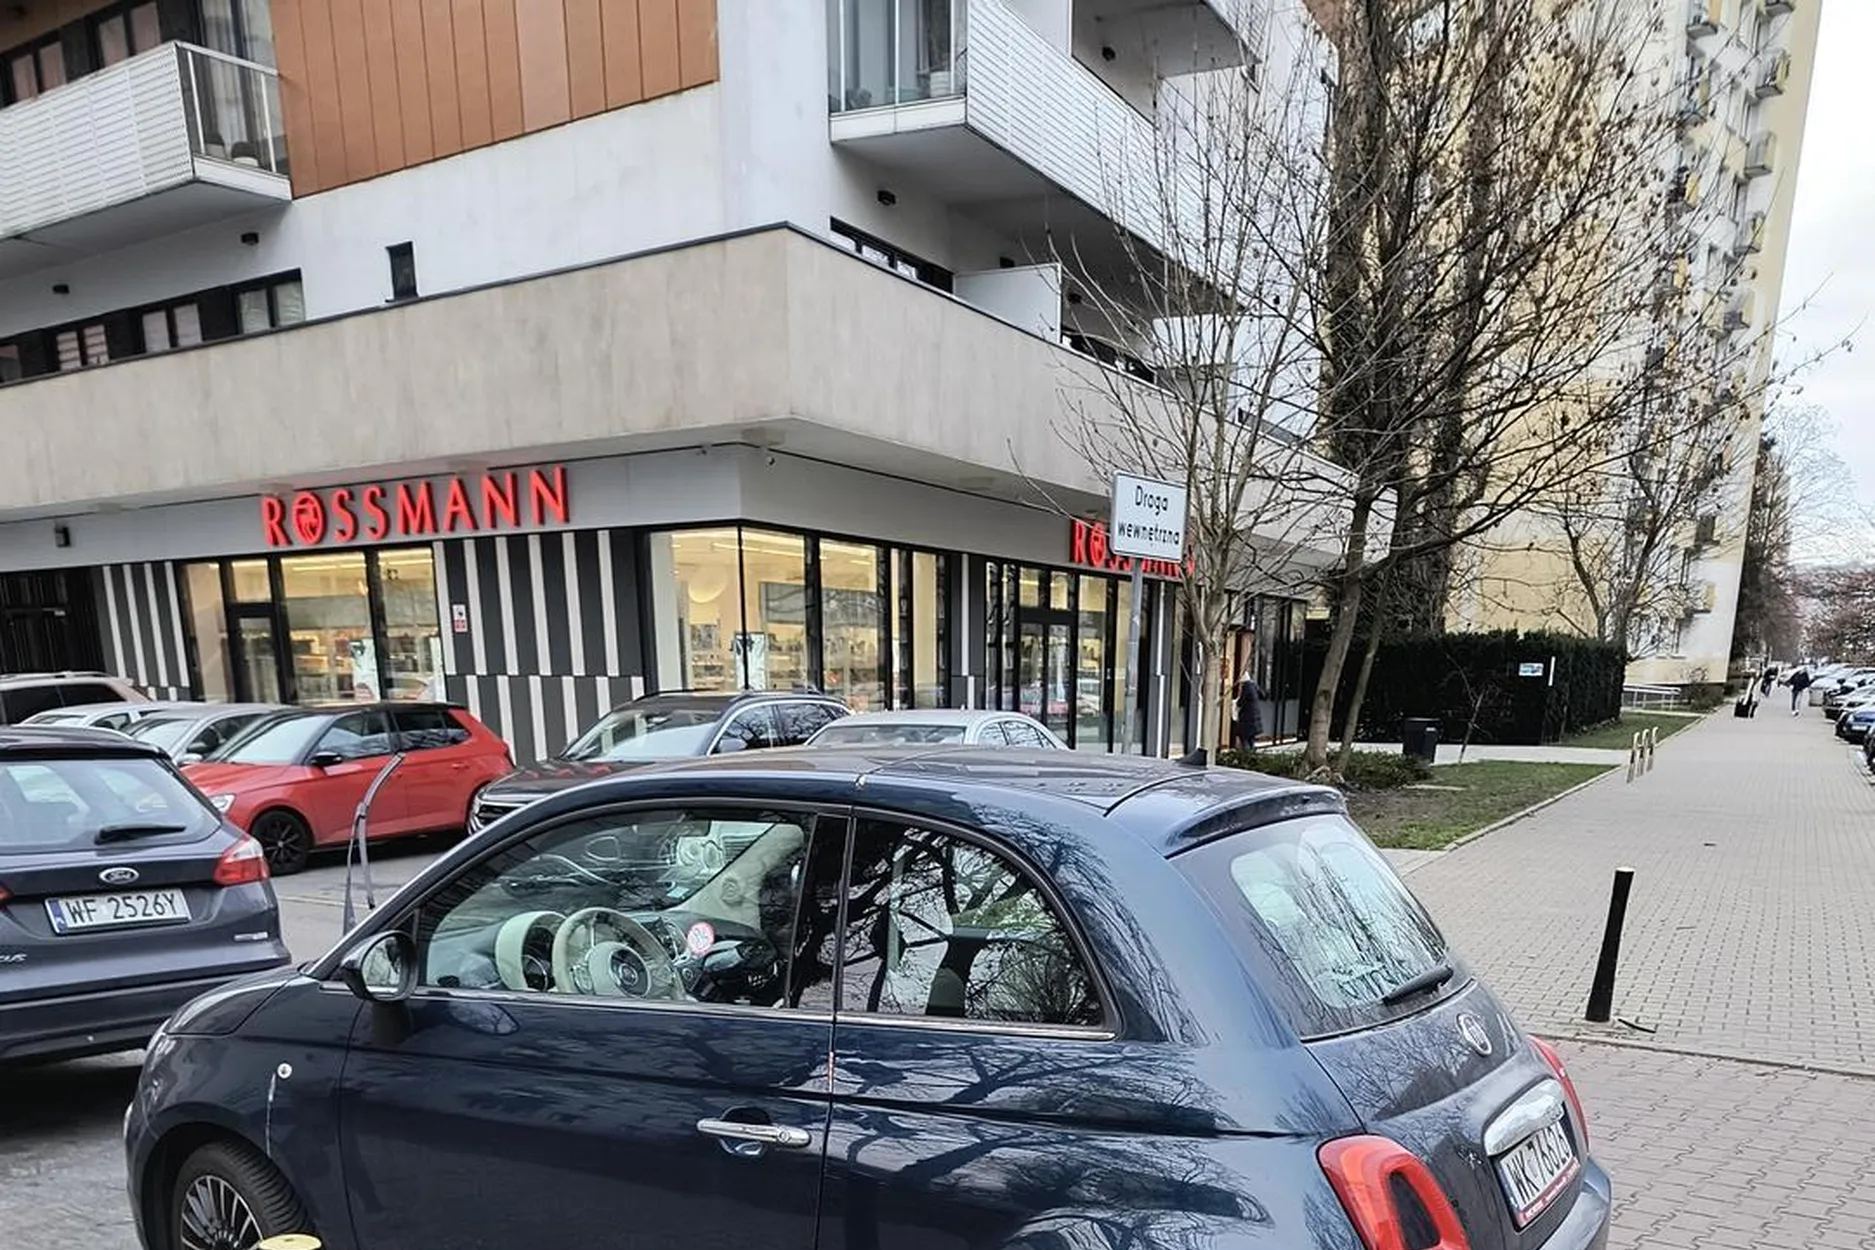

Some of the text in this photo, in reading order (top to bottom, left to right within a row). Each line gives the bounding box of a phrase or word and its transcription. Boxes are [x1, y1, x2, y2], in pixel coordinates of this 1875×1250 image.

[262, 466, 567, 546] ROSSMANN
[1135, 485, 1168, 515] Droga
[1118, 523, 1179, 546] wewnętrzna
[66, 894, 176, 924] WF 2526Y
[1506, 1150, 1540, 1205] WK
